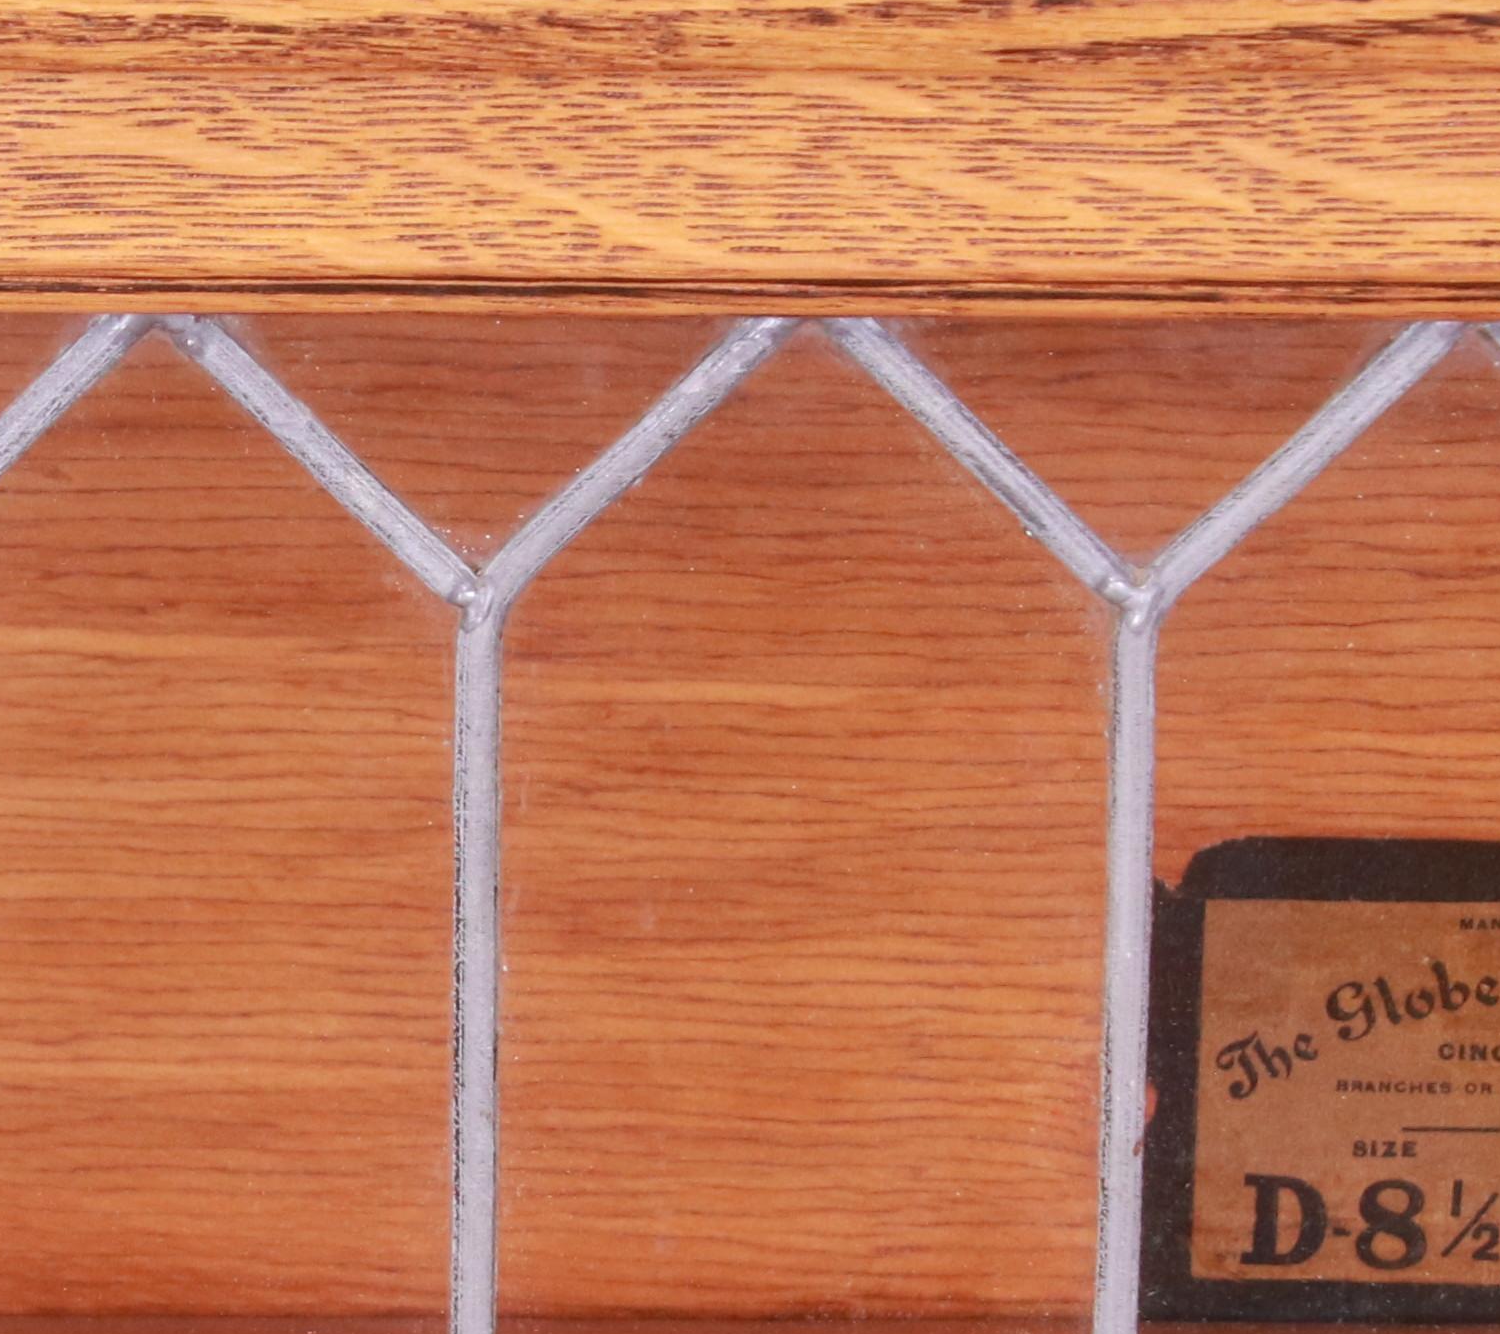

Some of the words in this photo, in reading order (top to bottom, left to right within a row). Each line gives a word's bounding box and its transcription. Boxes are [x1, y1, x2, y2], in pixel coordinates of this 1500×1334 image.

[1215, 1030, 1319, 1100] The
[1335, 1079, 1452, 1094] BRANCHES
[1464, 1081, 1493, 1095] OR
[1352, 1140, 1418, 1158] SIZE
